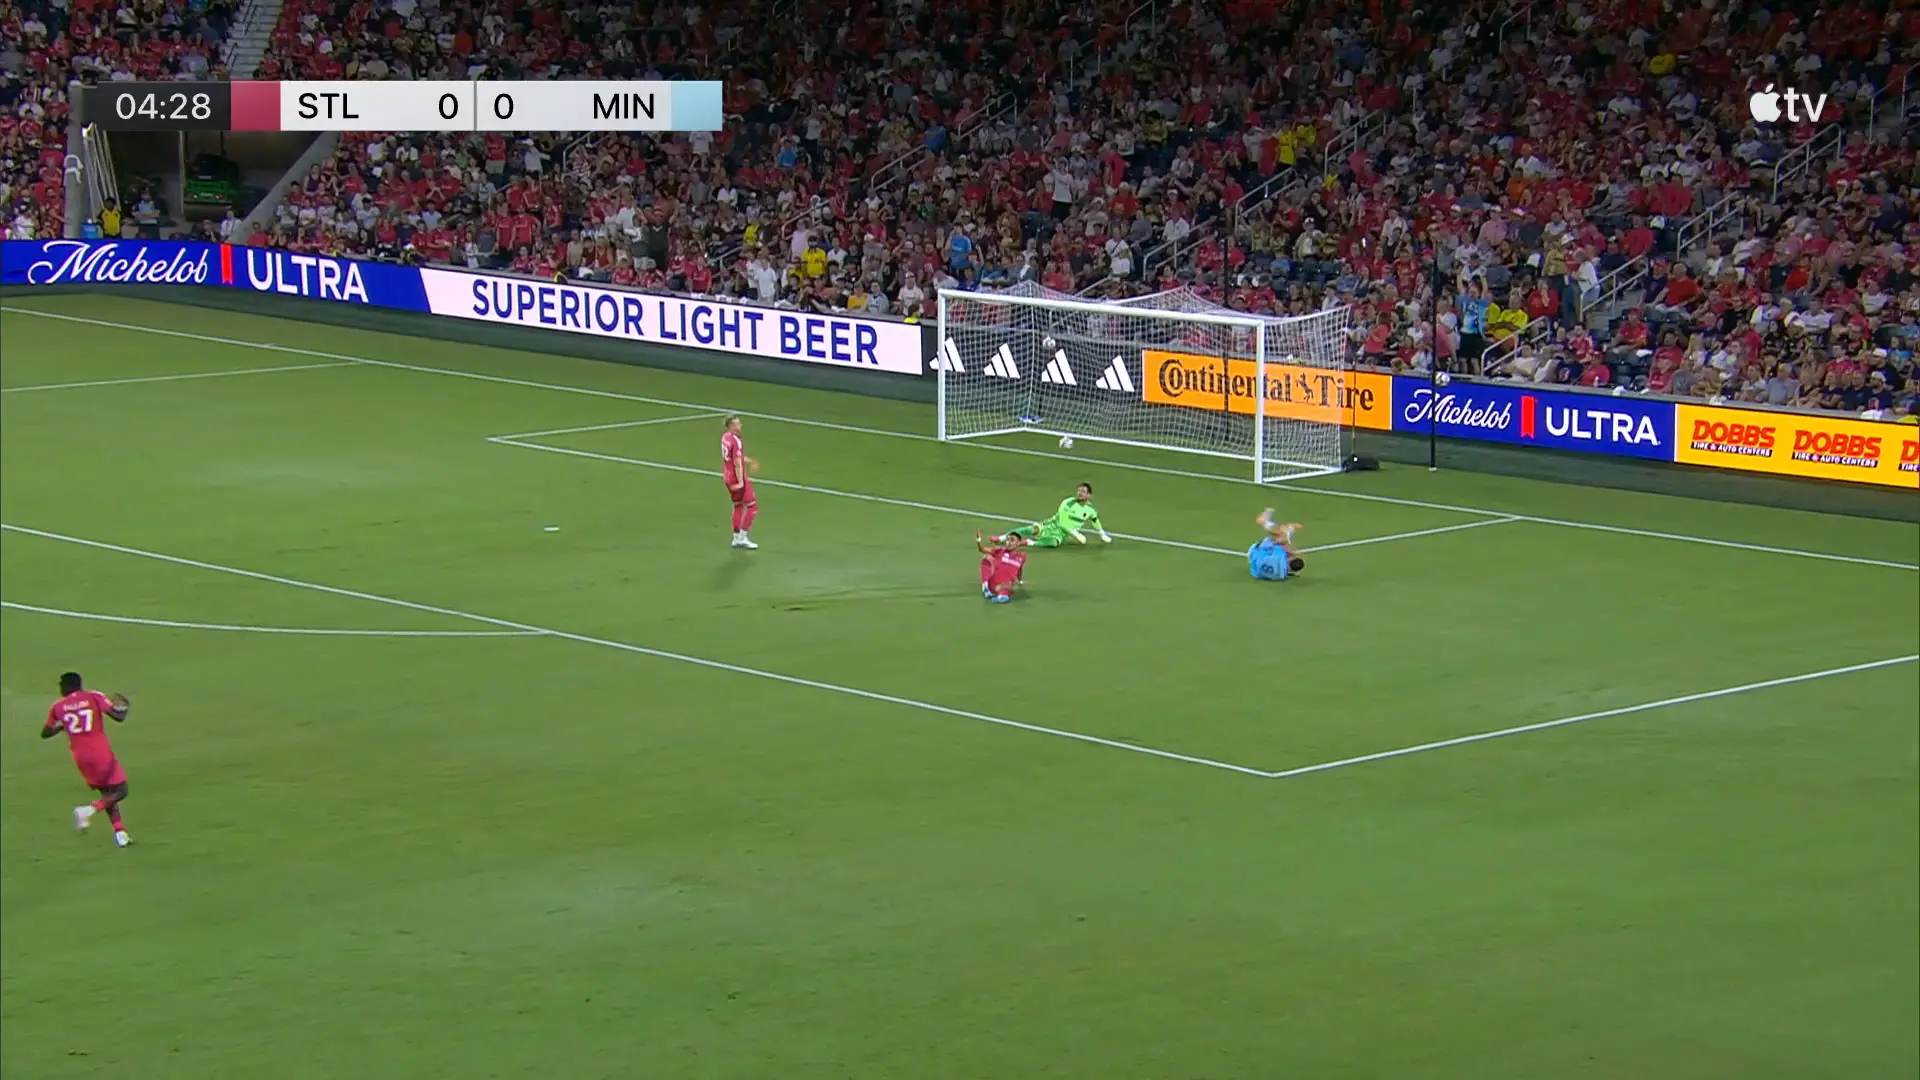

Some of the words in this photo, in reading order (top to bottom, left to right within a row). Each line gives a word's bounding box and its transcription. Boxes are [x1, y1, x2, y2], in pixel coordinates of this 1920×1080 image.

[28, 240, 208, 284] Michelob
[247, 250, 369, 303] ULTRA
[472, 279, 645, 336] SUPERIOR
[660, 299, 764, 350] LIGHT
[780, 315, 879, 364] BEER
[1313, 374, 1374, 411] Tire
[1404, 389, 1512, 430] Michelob
[1545, 406, 1659, 446] ULTRA
[1692, 419, 1776, 448] DOBBS
[1793, 429, 1882, 458] DOBBS
[63, 708, 94, 734] 27
